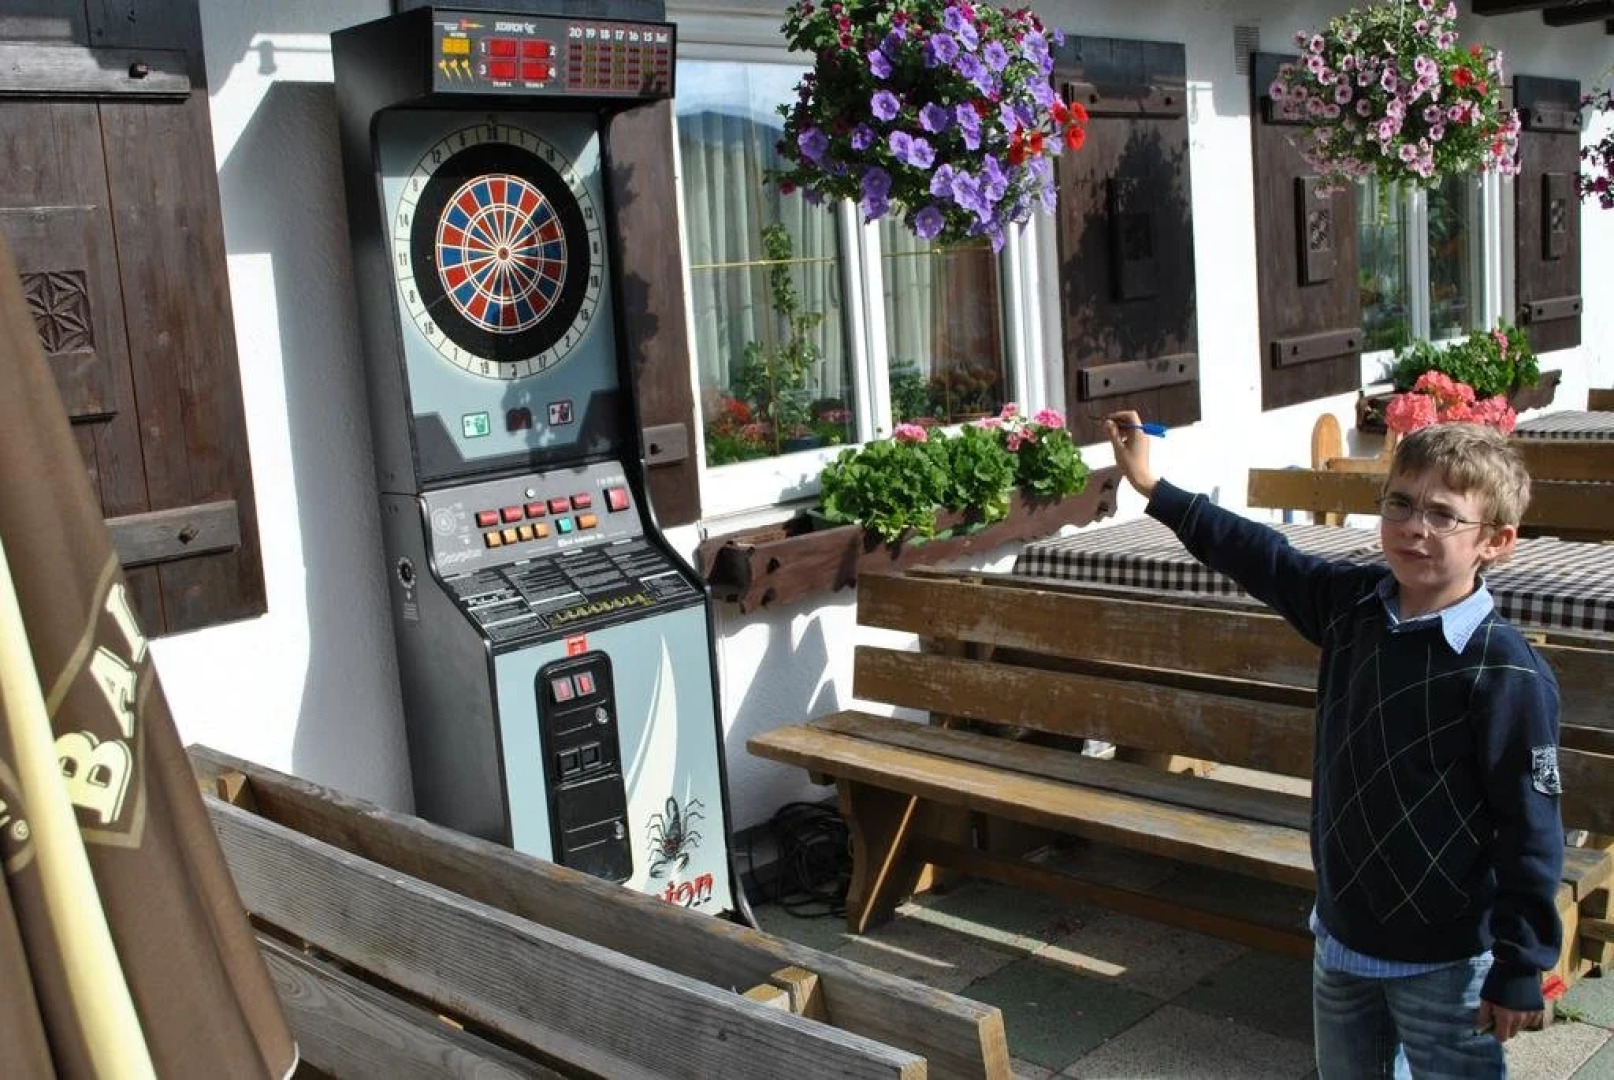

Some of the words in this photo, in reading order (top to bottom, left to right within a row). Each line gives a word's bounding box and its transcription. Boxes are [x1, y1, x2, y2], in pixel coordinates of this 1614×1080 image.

[568, 27, 583, 39] 20
[614, 29, 625, 41] 17
[643, 32, 653, 42] 15
[480, 42, 487, 53] 1
[549, 45, 556, 56] 2
[479, 64, 487, 75] 3
